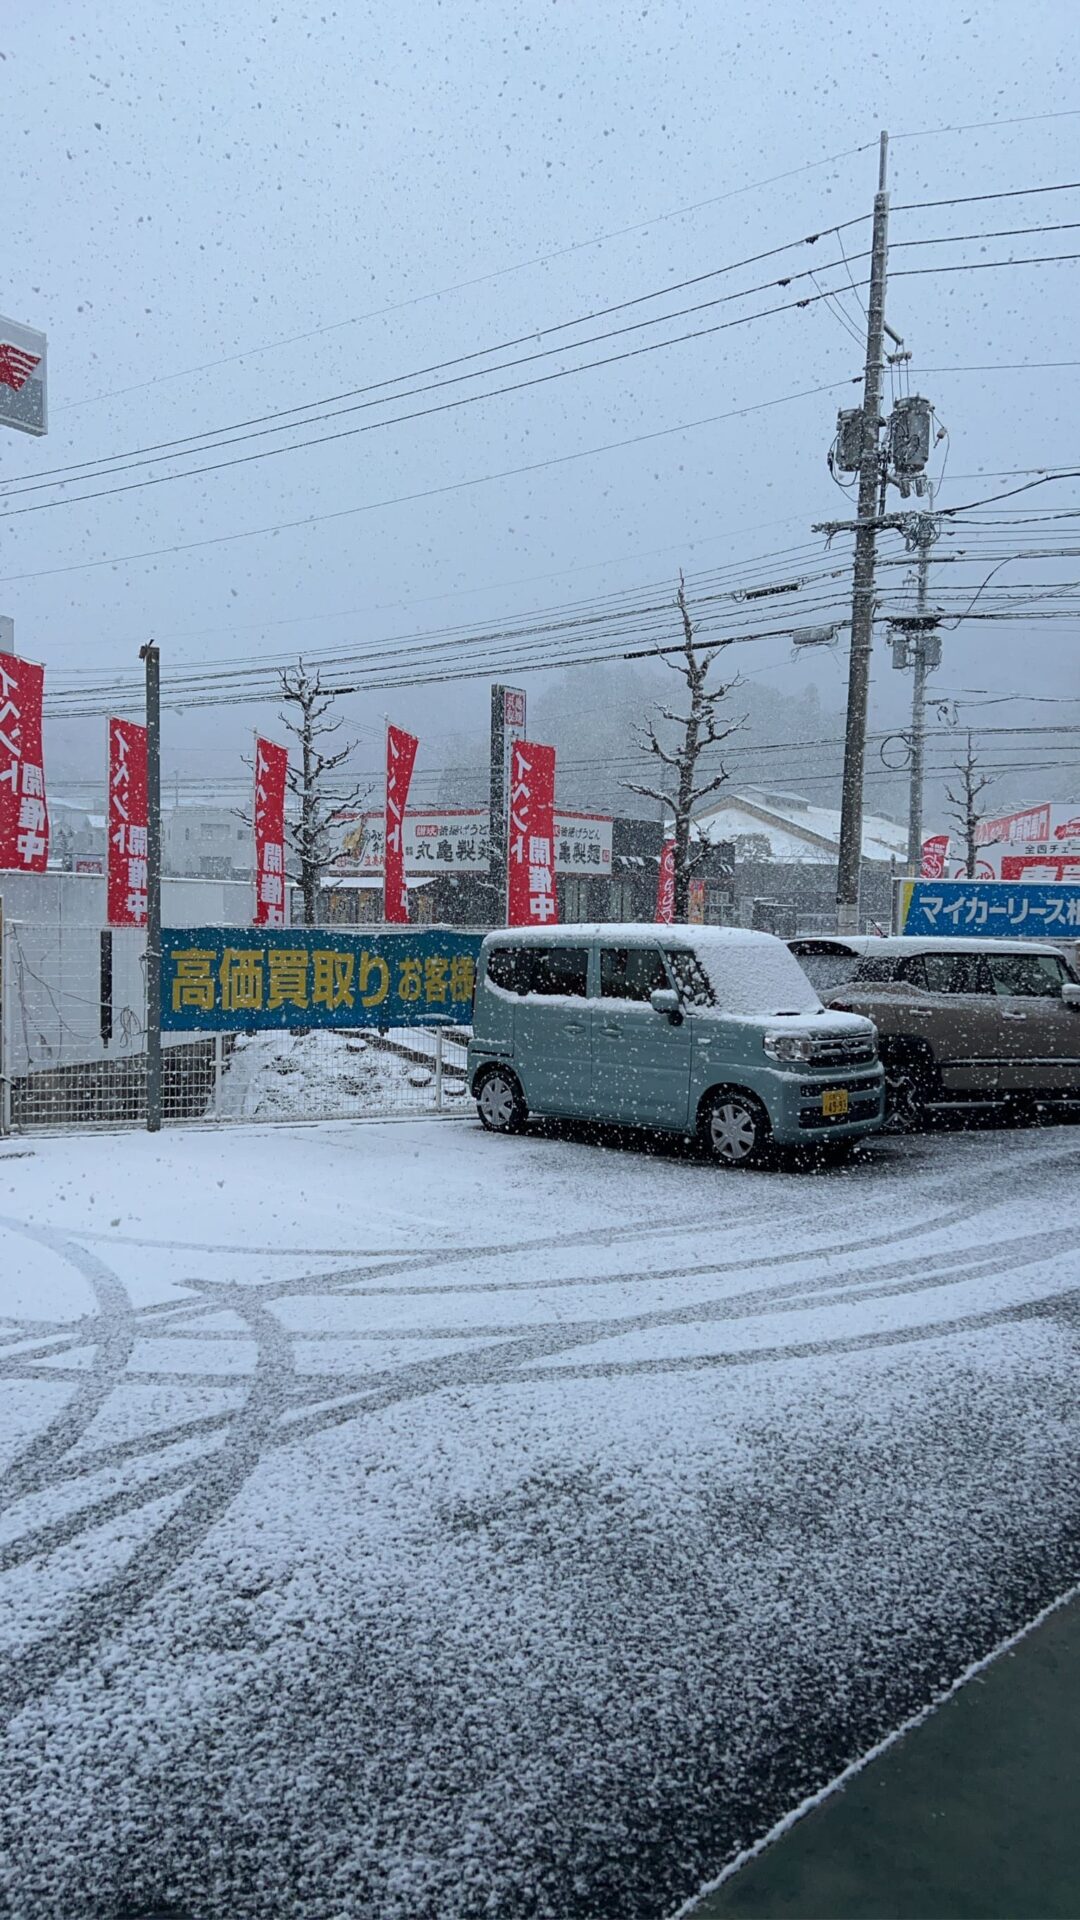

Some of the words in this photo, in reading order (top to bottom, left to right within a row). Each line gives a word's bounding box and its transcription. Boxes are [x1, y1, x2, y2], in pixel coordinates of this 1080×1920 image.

[170, 948, 390, 1012] 高価買取り
[397, 956, 475, 1002] お客様
